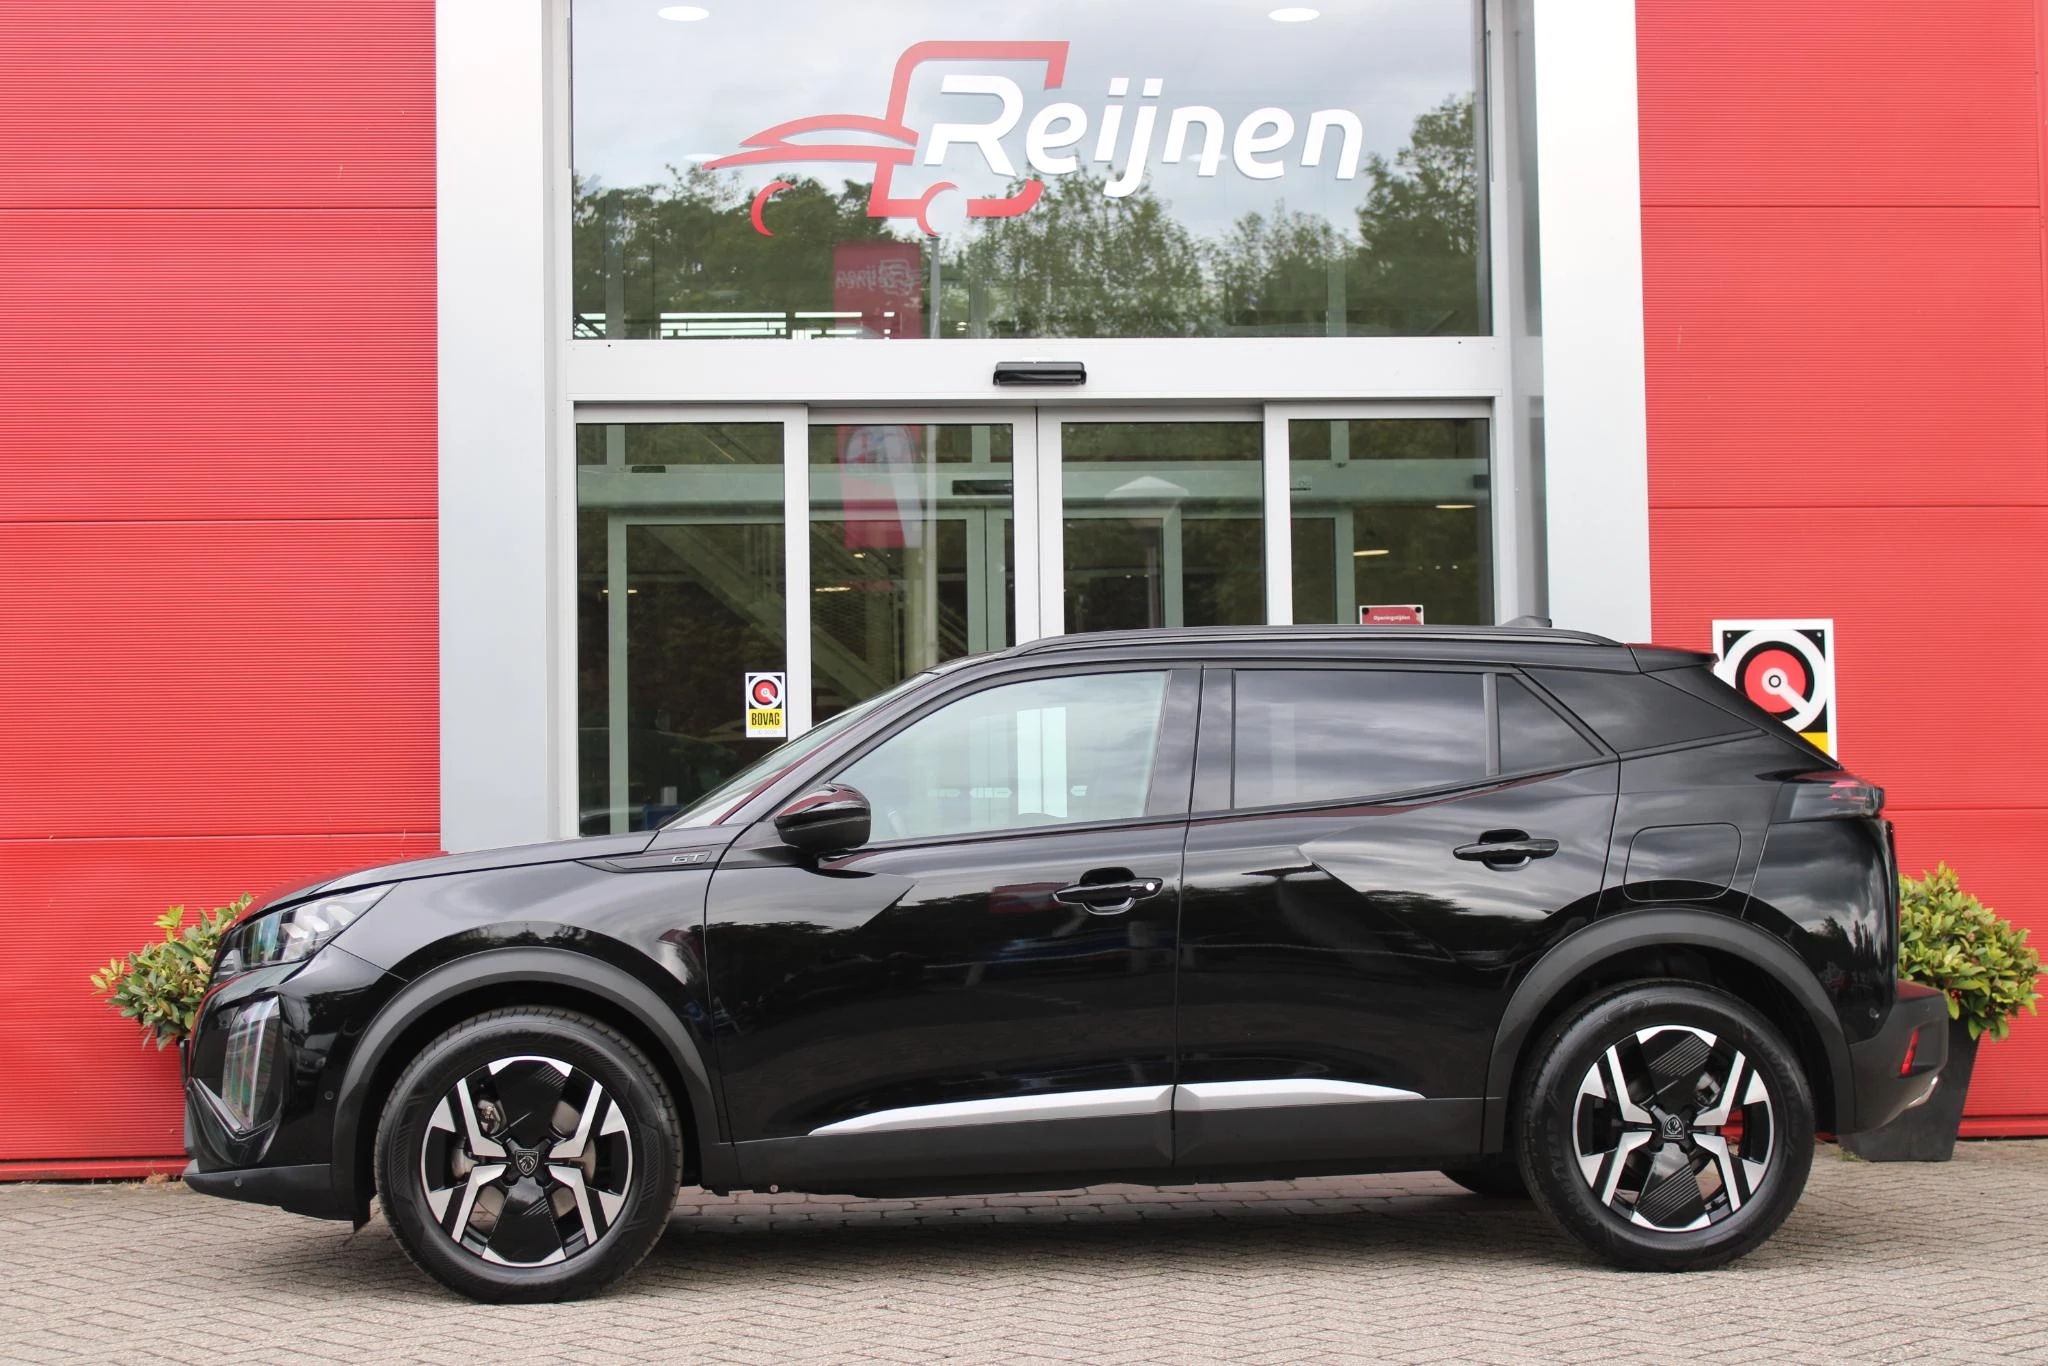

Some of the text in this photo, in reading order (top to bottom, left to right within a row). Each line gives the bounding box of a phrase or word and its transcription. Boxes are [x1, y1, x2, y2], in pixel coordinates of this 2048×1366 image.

[923, 74, 1363, 198] Reijnen
[751, 712, 780, 726] BOVAG
[671, 854, 705, 864] GT
